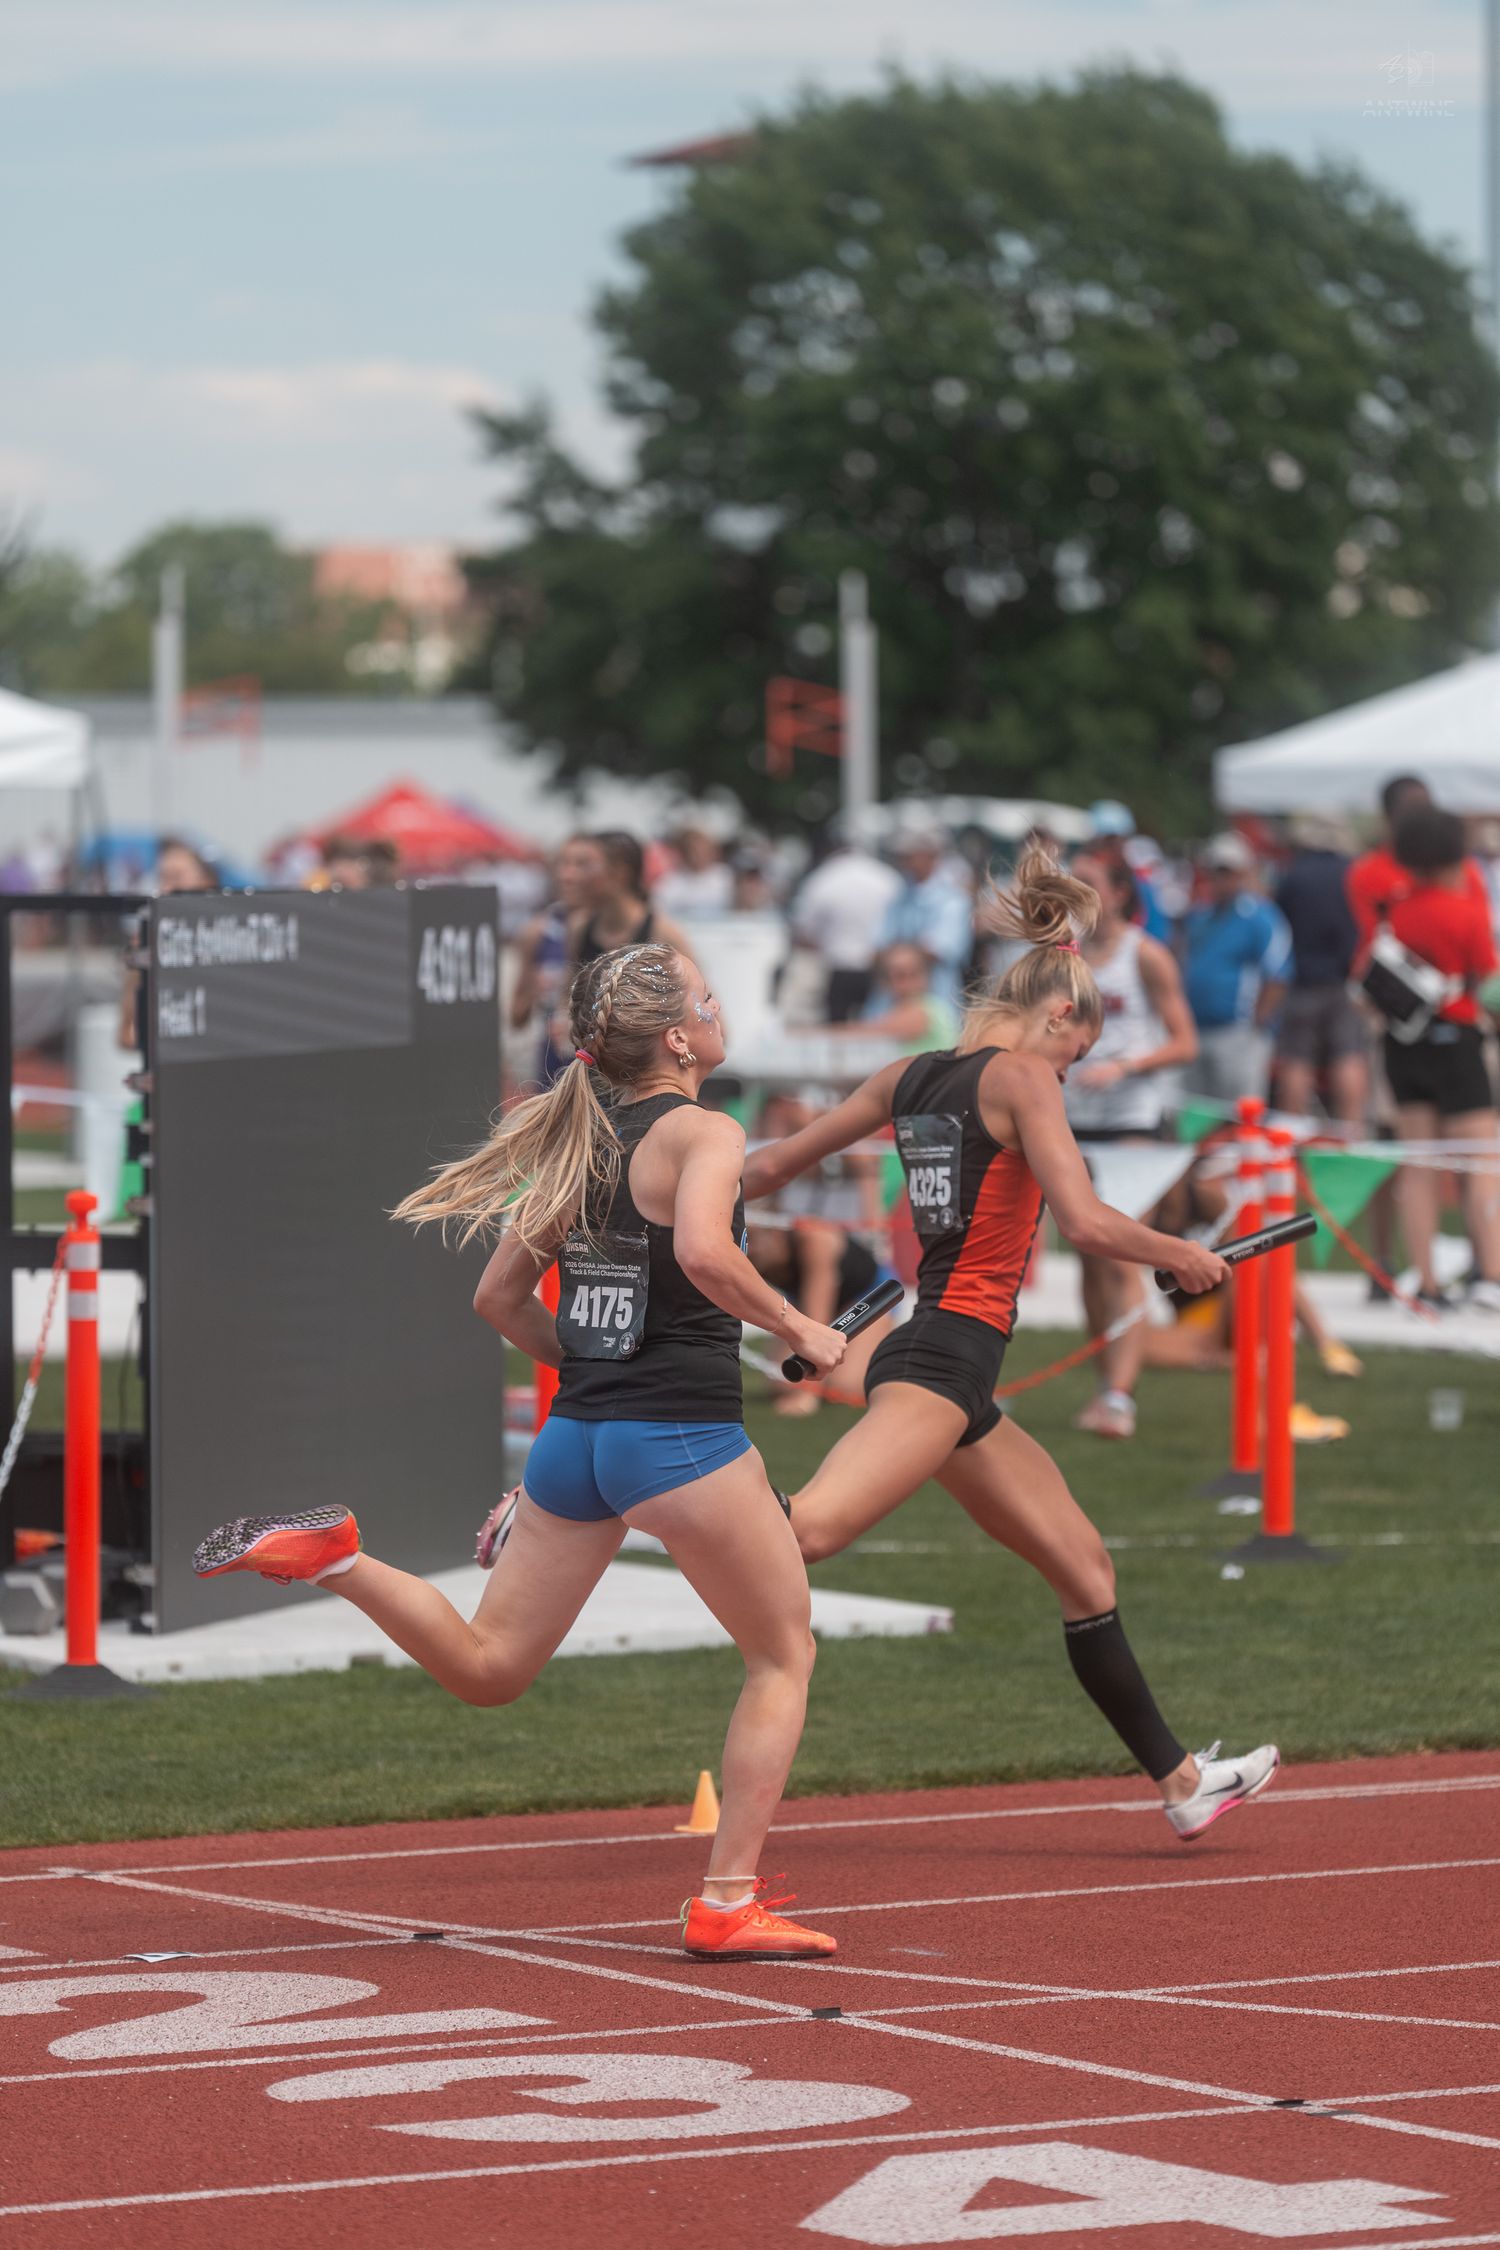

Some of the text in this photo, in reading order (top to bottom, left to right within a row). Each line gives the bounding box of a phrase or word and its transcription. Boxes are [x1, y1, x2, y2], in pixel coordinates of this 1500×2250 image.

[909, 1166, 952, 1207] 4325
[600, 1270, 638, 1279] Championships
[628, 1264, 641, 1272] State
[569, 1285, 634, 1330] 4175
[0, 1971, 556, 2060] 2
[265, 2053, 912, 2142] 3
[797, 2141, 1456, 2246] 4
